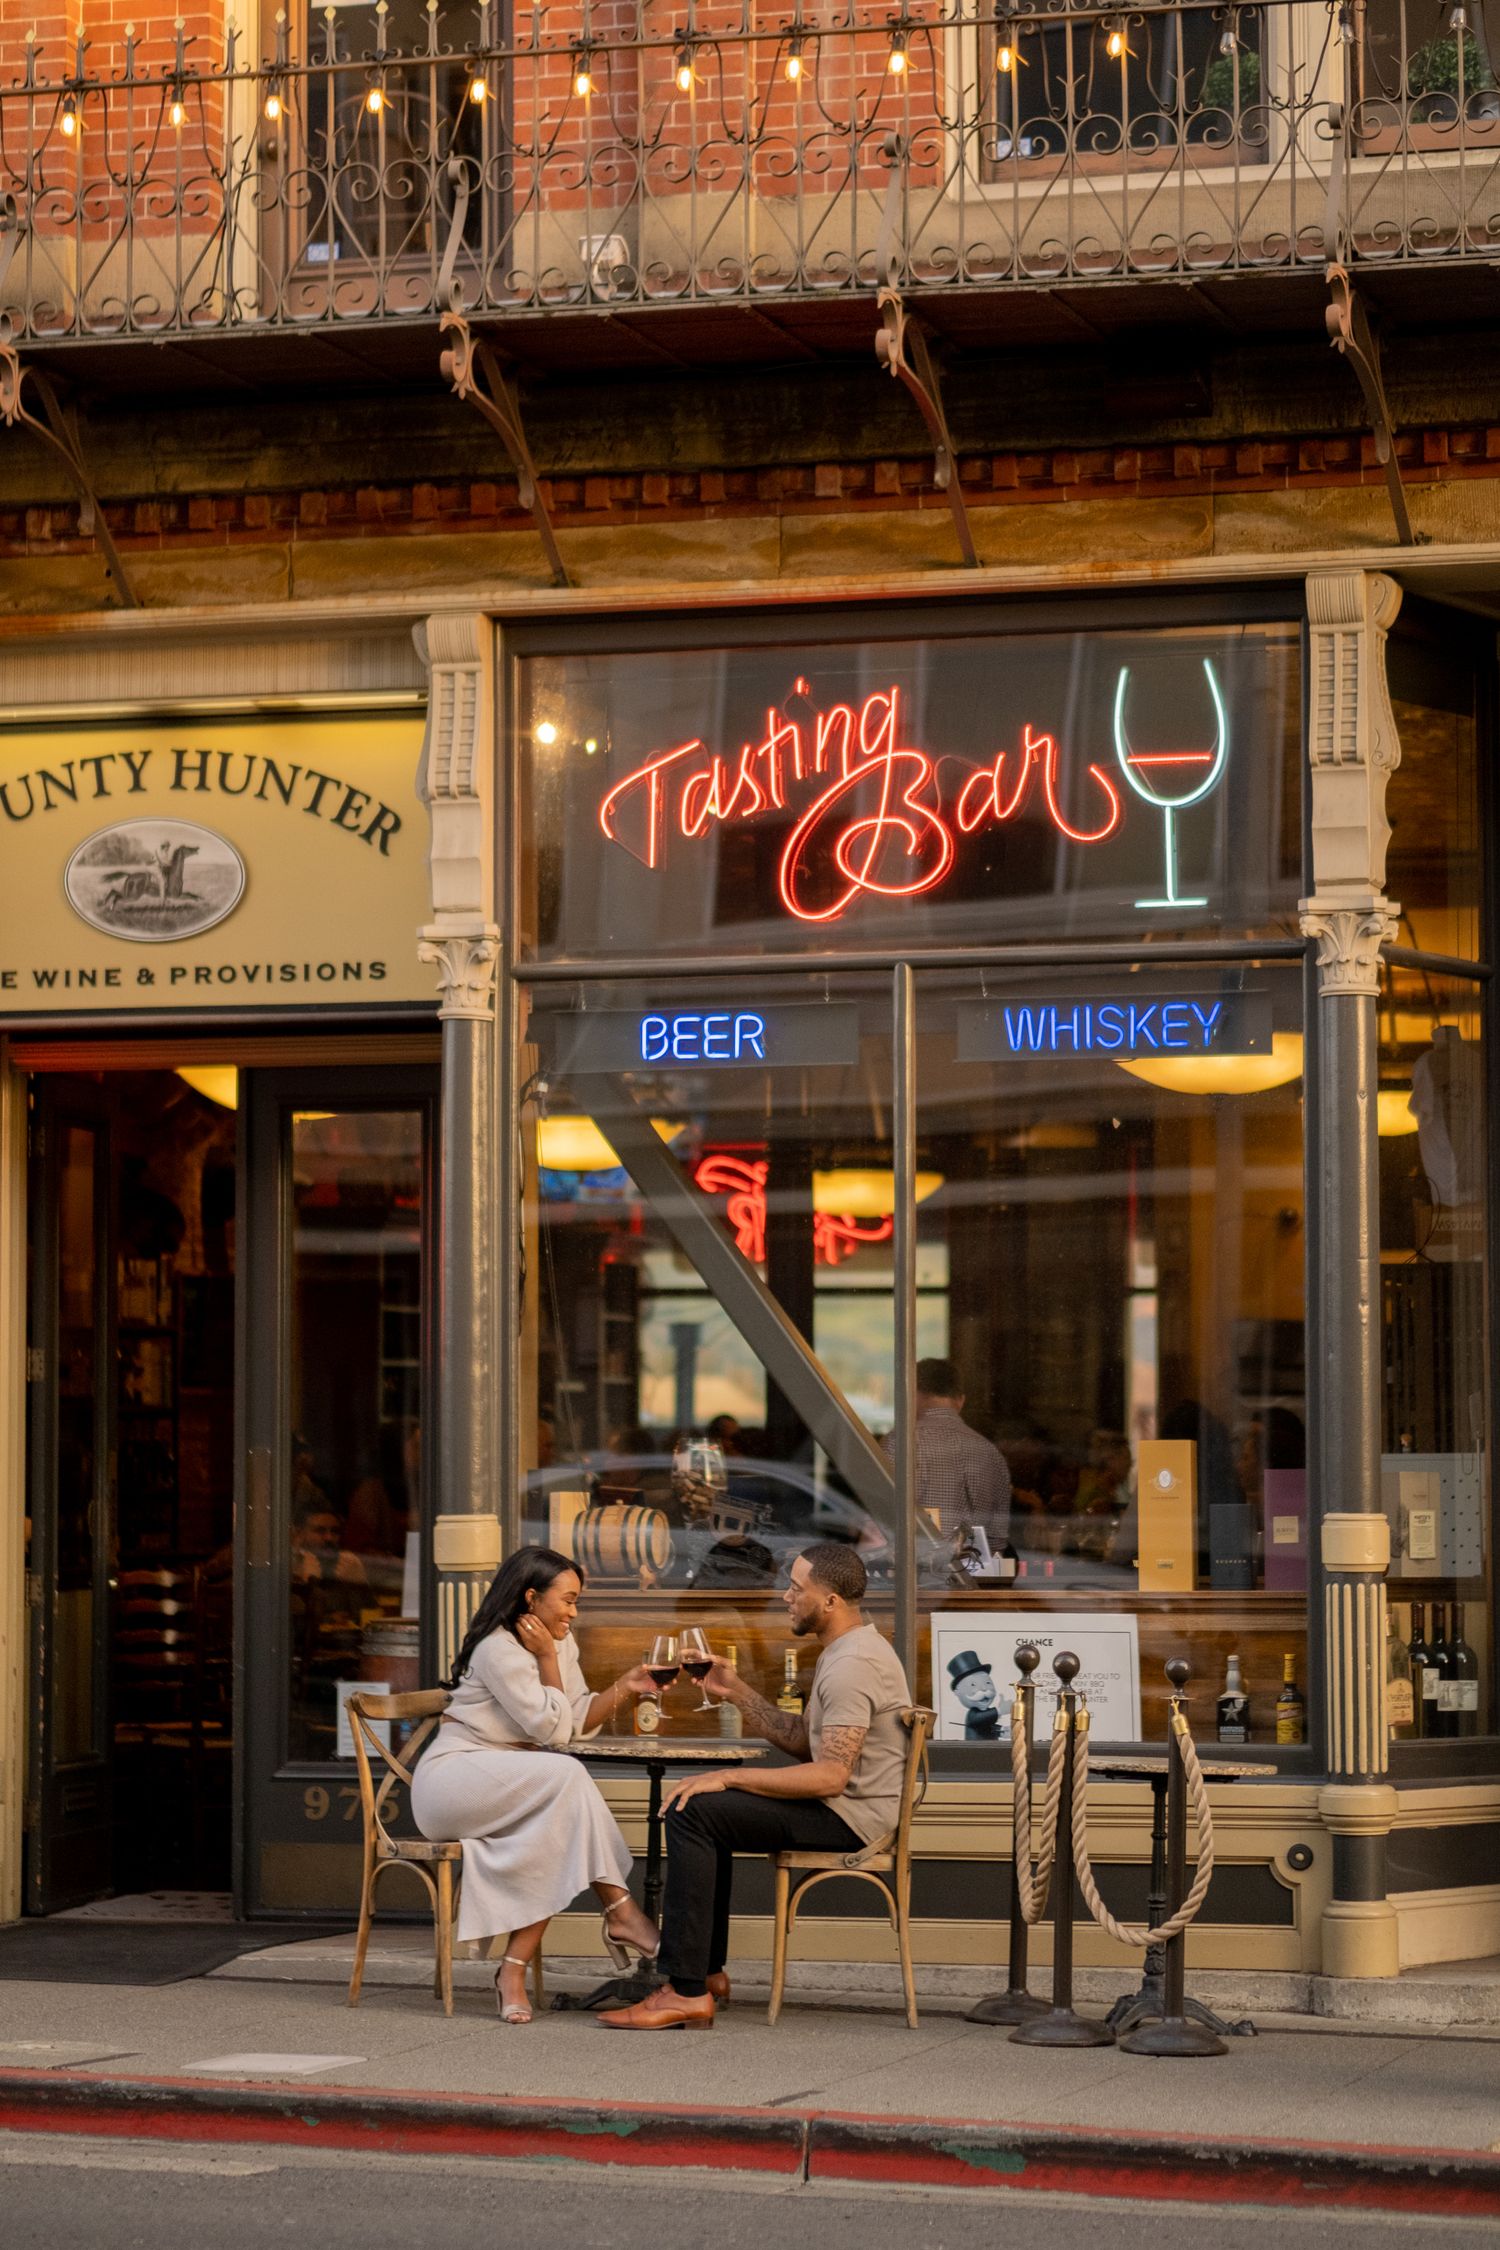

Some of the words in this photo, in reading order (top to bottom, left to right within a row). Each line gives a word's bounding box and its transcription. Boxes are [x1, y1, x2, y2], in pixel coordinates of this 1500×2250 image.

[170, 748, 403, 857] HUNTER
[600, 676, 901, 886] Tasting
[779, 723, 1122, 922] Bar
[34, 967, 122, 989] WINE
[137, 967, 155, 986] &
[170, 961, 388, 986] PROVISIONS
[640, 1012, 767, 1063] BEER
[1004, 999, 1223, 1054] WHISKEY
[1015, 1638, 1054, 1647] CHANCE
[304, 1785, 400, 1824] 975
